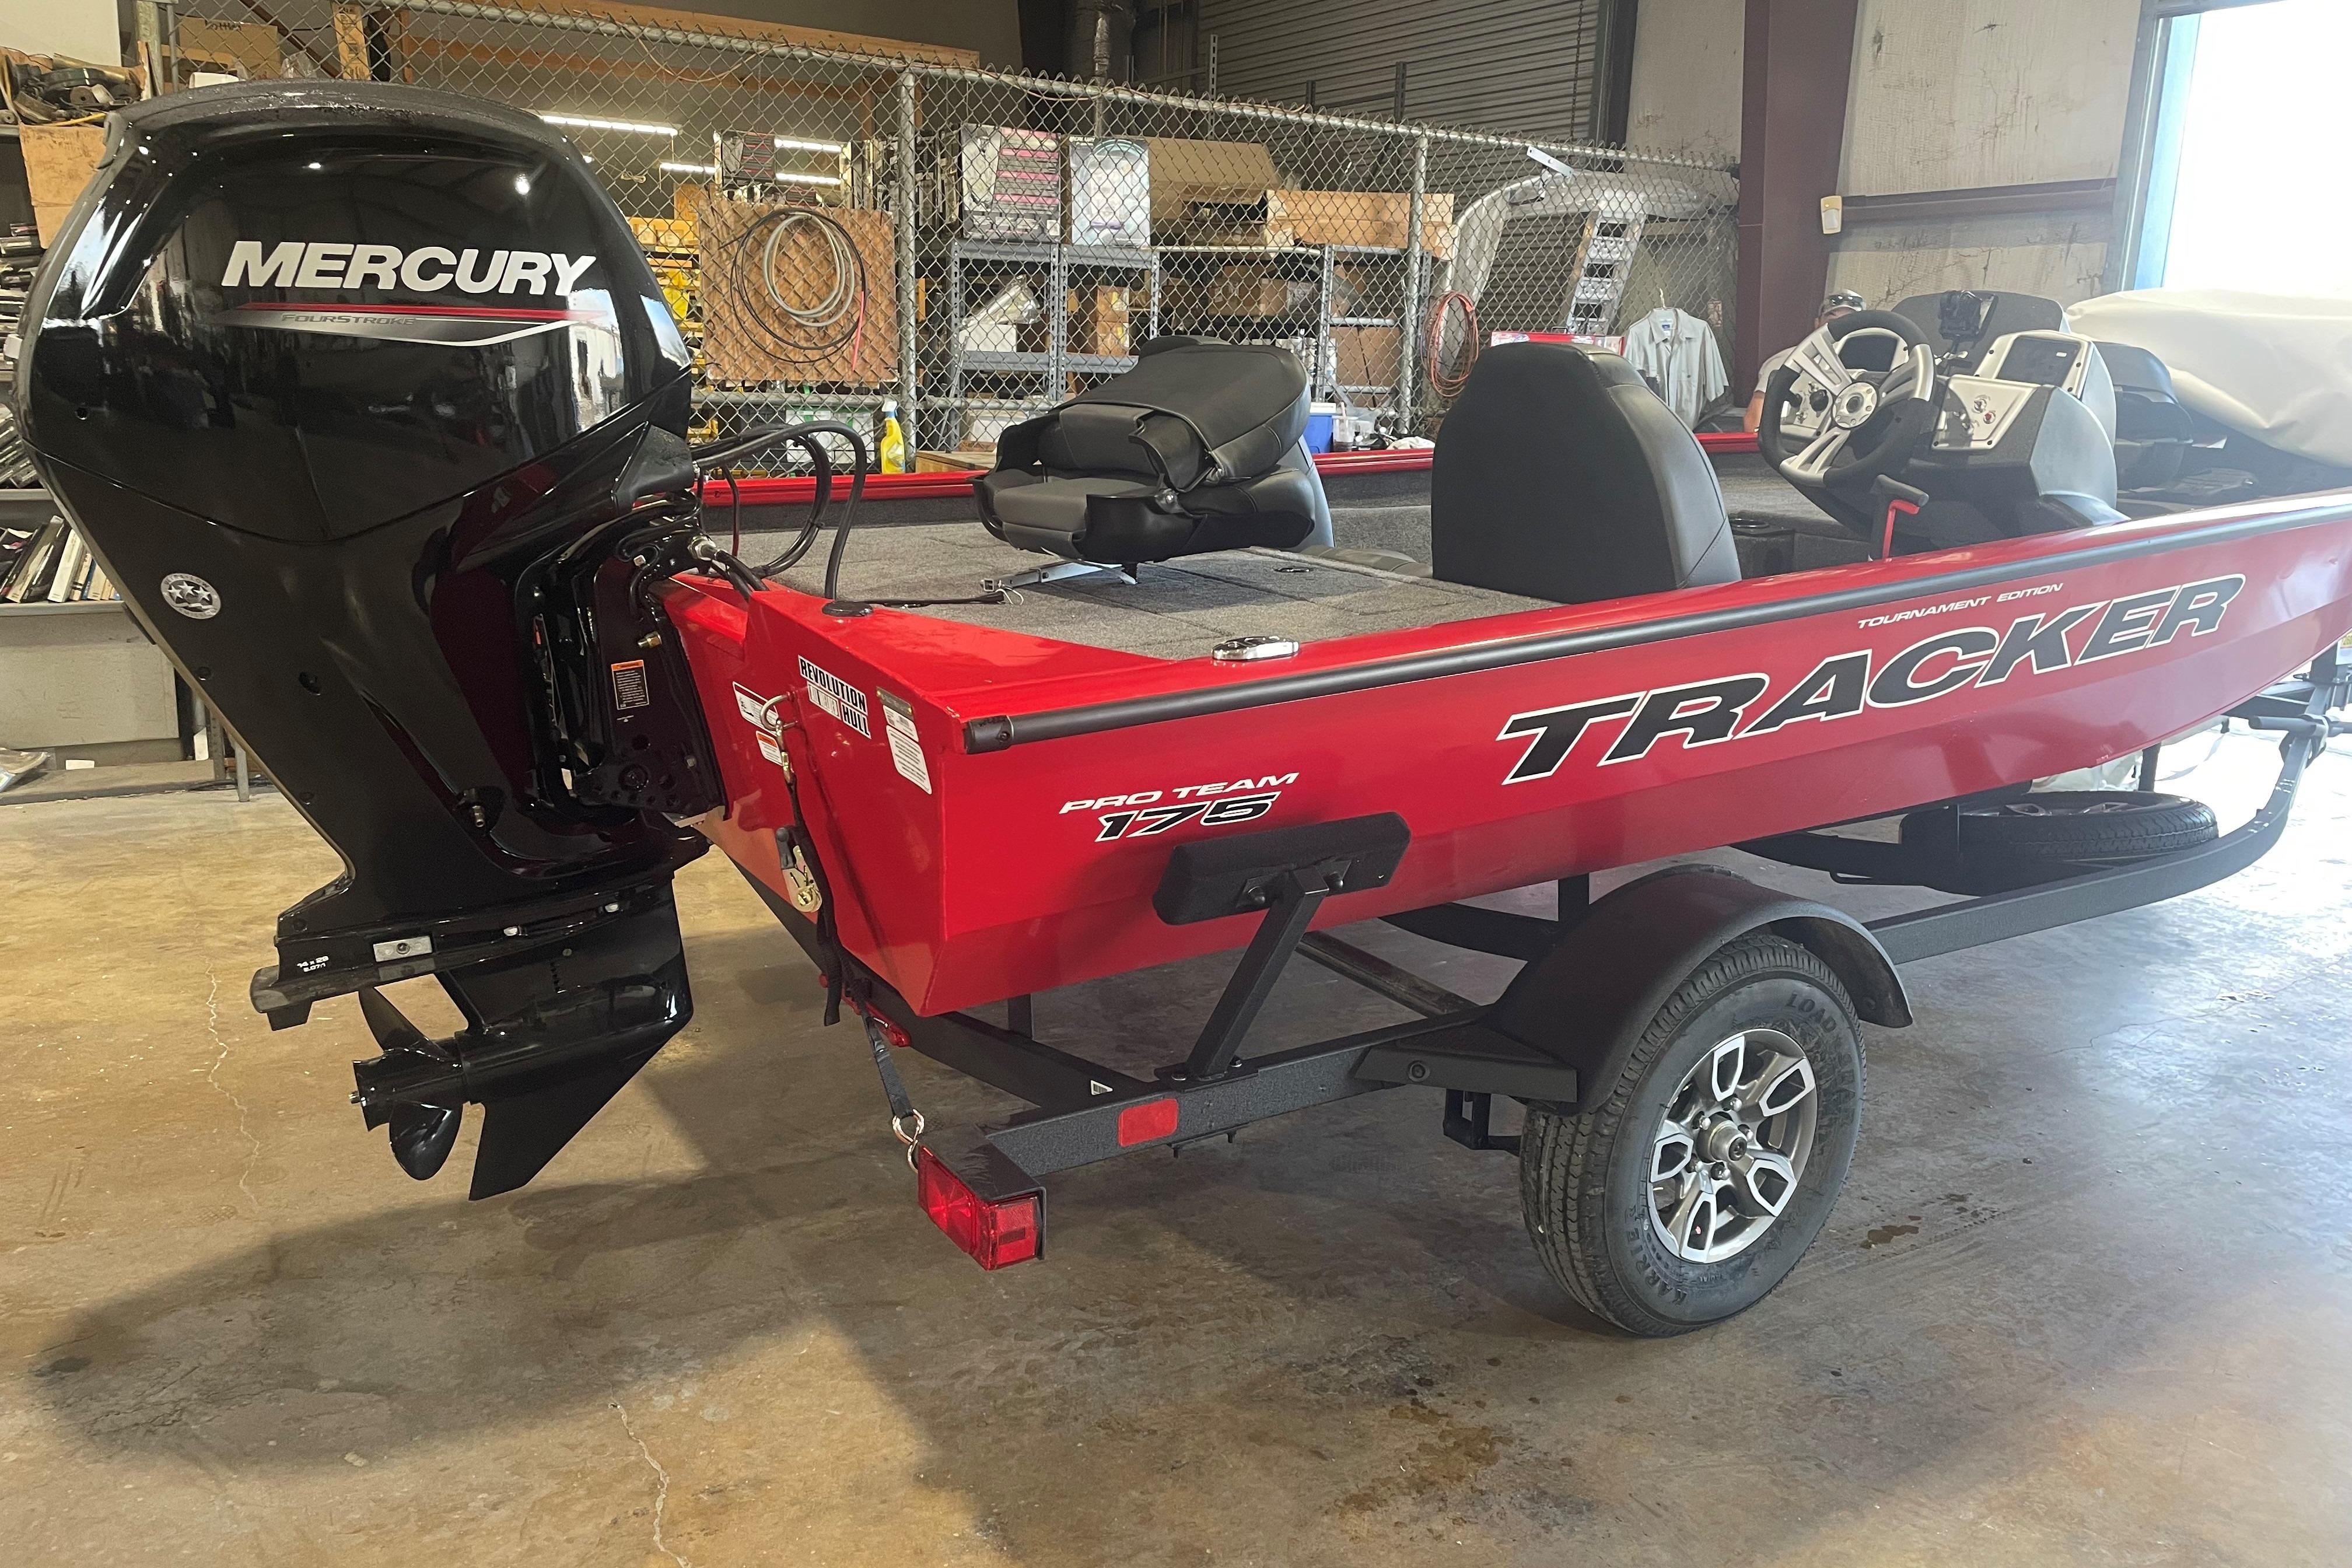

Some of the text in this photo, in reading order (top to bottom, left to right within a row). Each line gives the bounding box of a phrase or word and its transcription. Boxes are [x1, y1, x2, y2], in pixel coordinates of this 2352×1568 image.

[222, 240, 596, 296] MERCURY
[1857, 582, 2064, 629] TOURNAMENT EDITION
[800, 657, 866, 712] REVOLUTION
[1496, 573, 2246, 786] TRACKER
[842, 704, 870, 736] HULL
[1059, 772, 1300, 815] PRO TEAM
[1094, 790, 1282, 843] 175
[1785, 991, 1838, 1033] LOAD
[1625, 1203, 1688, 1306] KARRIER
